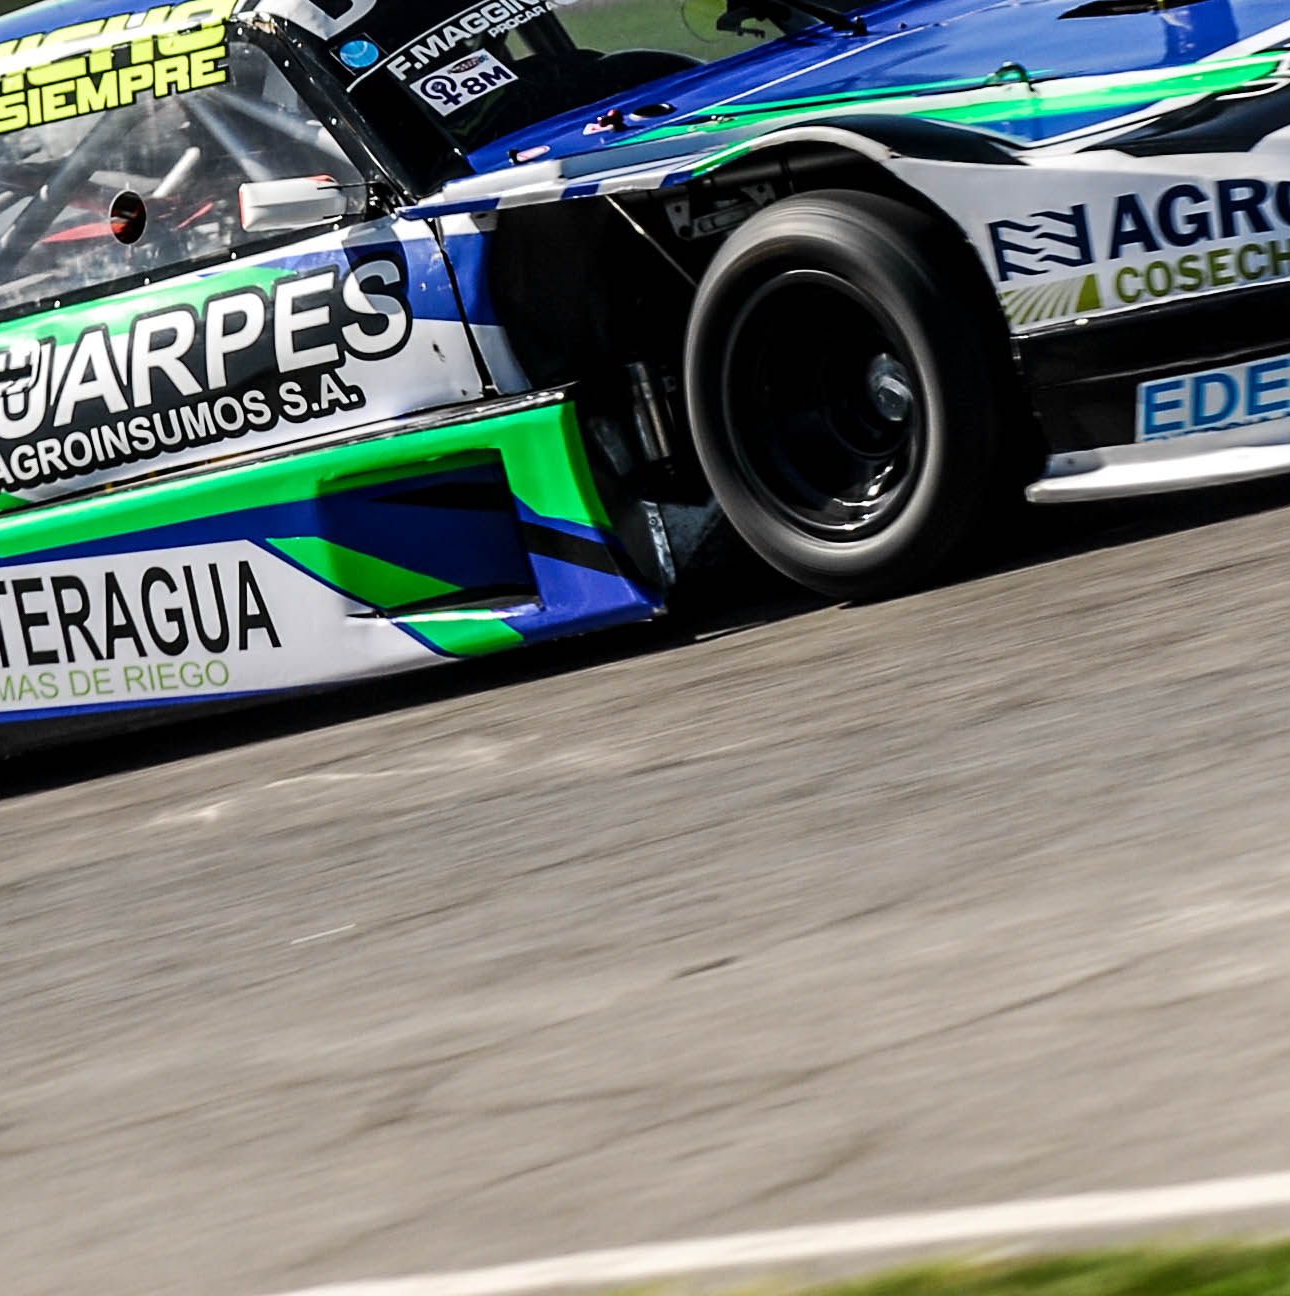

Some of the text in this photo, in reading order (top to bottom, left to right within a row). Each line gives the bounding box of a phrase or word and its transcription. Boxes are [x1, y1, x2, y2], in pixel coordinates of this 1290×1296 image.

[487, 6, 546, 39] PROCAR
[460, 65, 513, 95] 8M
[283, 373, 360, 418] S.A.
[69, 666, 115, 697] DE
[125, 659, 231, 693] RIEGO
